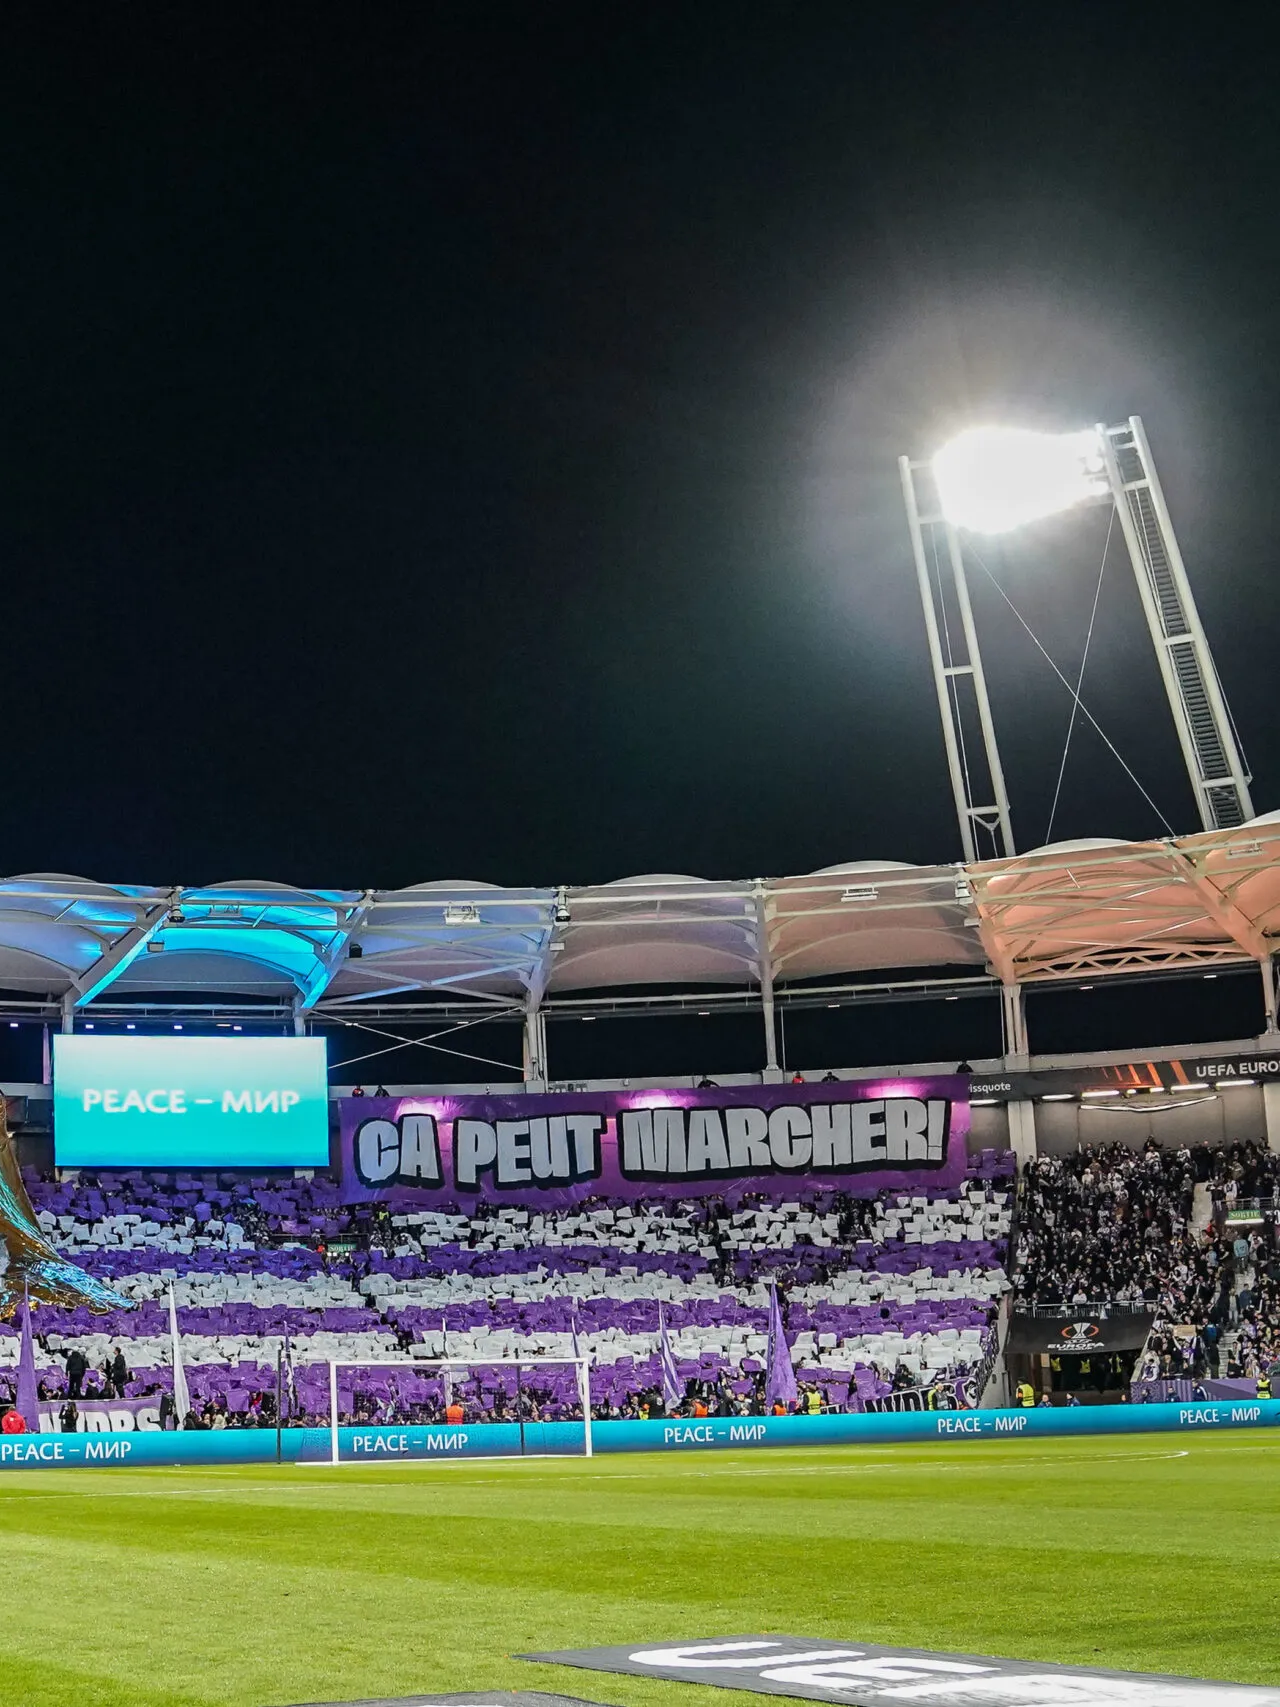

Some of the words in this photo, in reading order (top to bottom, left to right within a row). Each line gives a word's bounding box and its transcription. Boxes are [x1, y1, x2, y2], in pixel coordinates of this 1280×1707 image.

[1196, 1063, 1236, 1077] UEFA
[1239, 1060, 1280, 1074] EURO
[83, 1088, 187, 1114] PEACE
[221, 1090, 301, 1114] МИР
[456, 1114, 603, 1185] PEUT
[620, 1099, 947, 1174] MARCHER!
[937, 1416, 982, 1433] PEACE
[995, 1416, 1027, 1431] МИР
[1180, 1408, 1220, 1424] PEACE
[1231, 1407, 1260, 1421] МИР
[353, 1435, 409, 1453] PEACE
[427, 1433, 469, 1450] МИР
[664, 1426, 715, 1443] PEACE
[730, 1425, 767, 1441] МИР
[1, 1442, 65, 1461] PEACE
[85, 1441, 132, 1459] МИР
